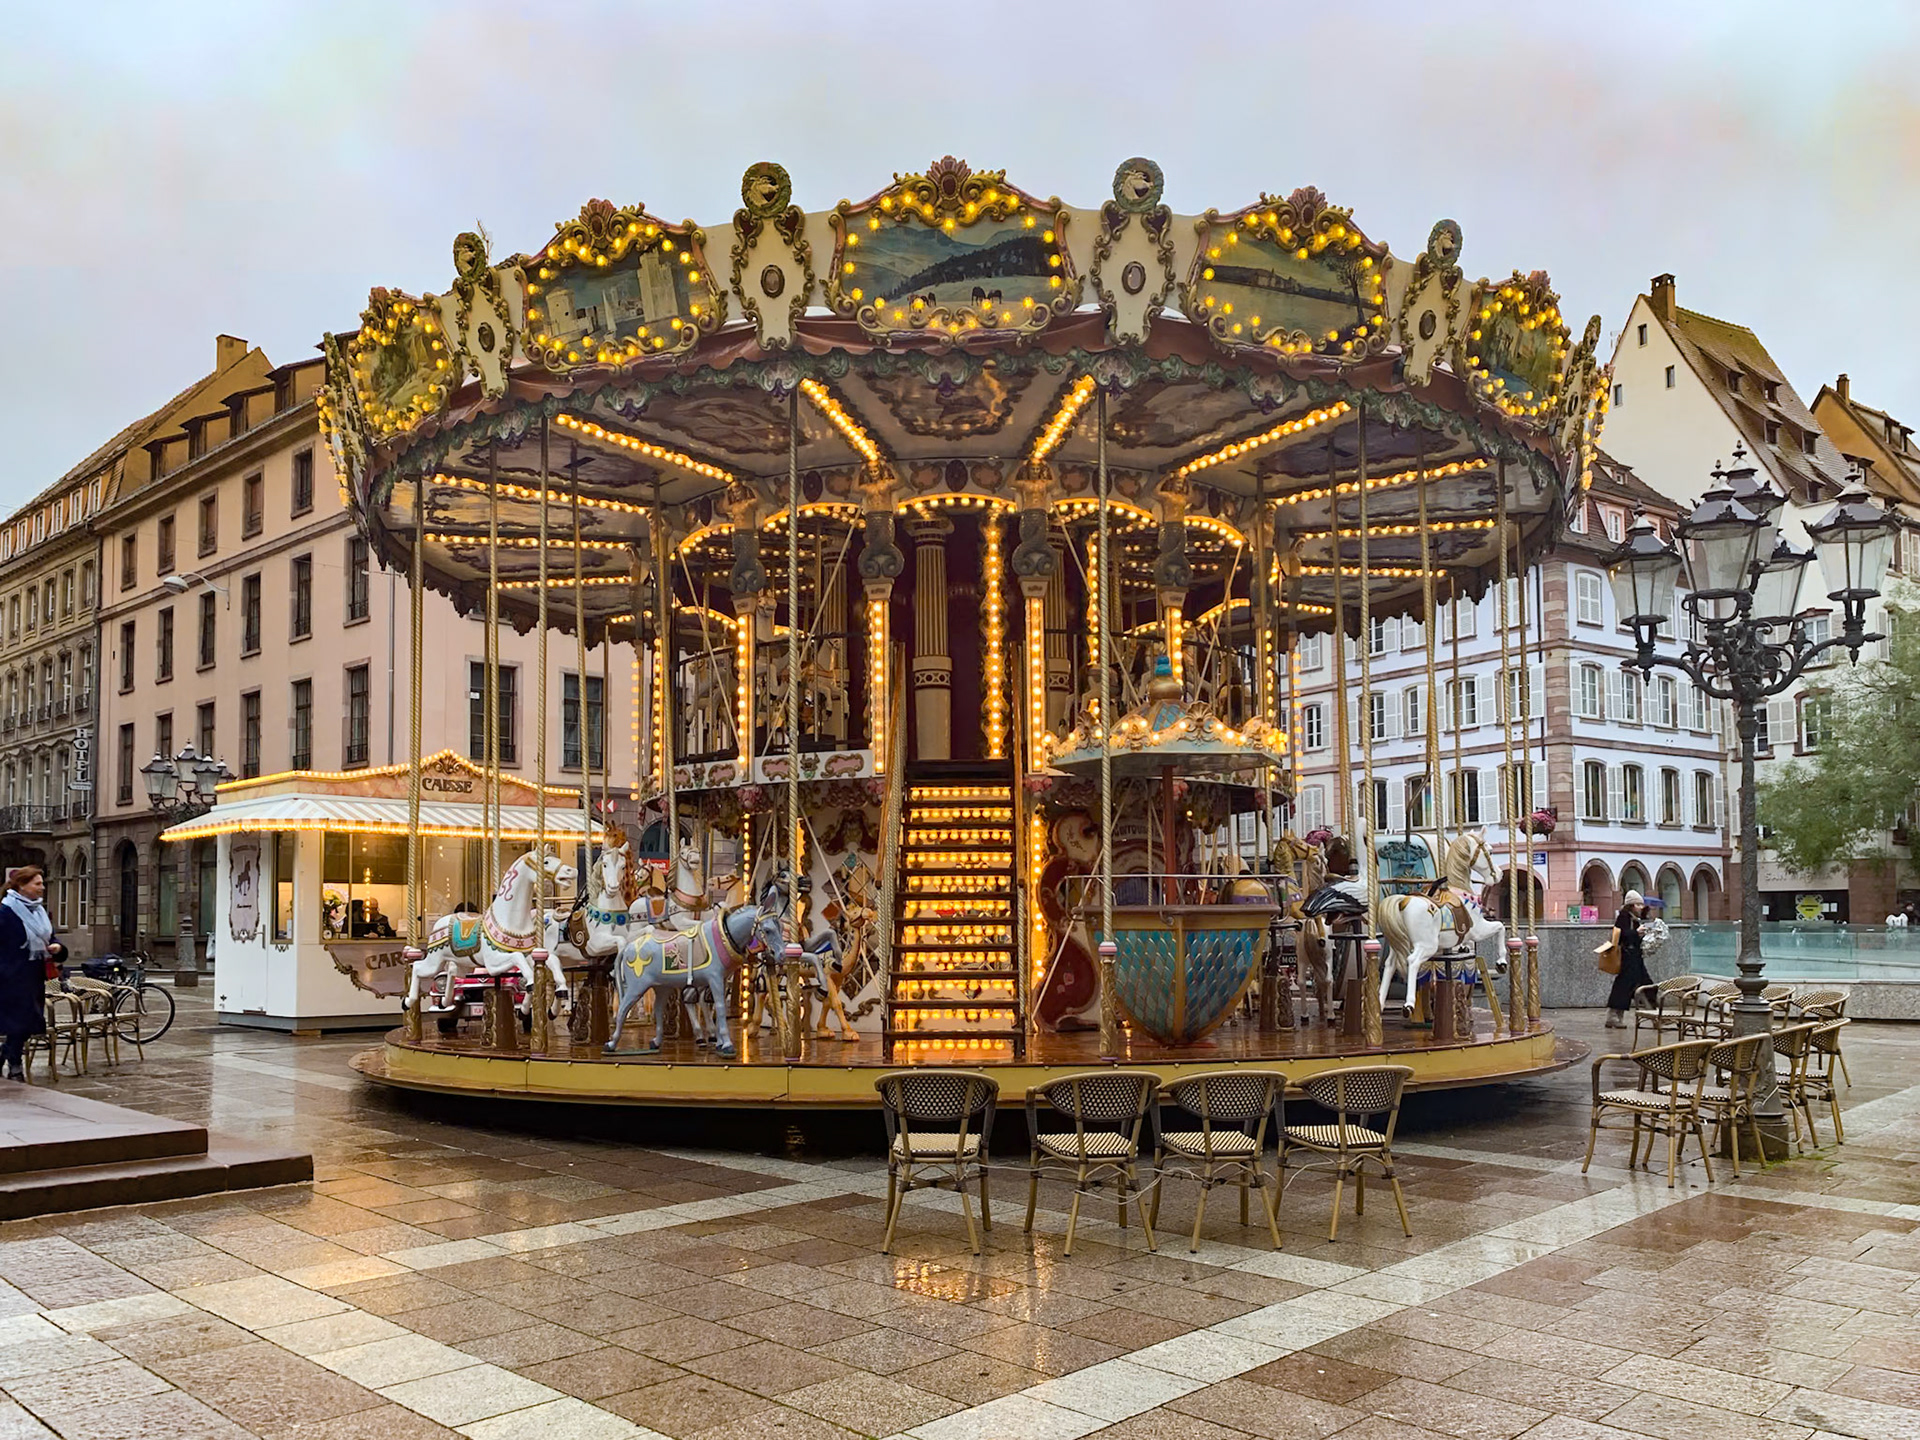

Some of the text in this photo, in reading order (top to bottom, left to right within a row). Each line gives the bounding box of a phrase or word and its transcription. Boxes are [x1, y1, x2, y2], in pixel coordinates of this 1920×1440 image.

[74, 727, 89, 781] HOTEL
[422, 777, 473, 794] CAISSE
[365, 951, 405, 970] CAR
